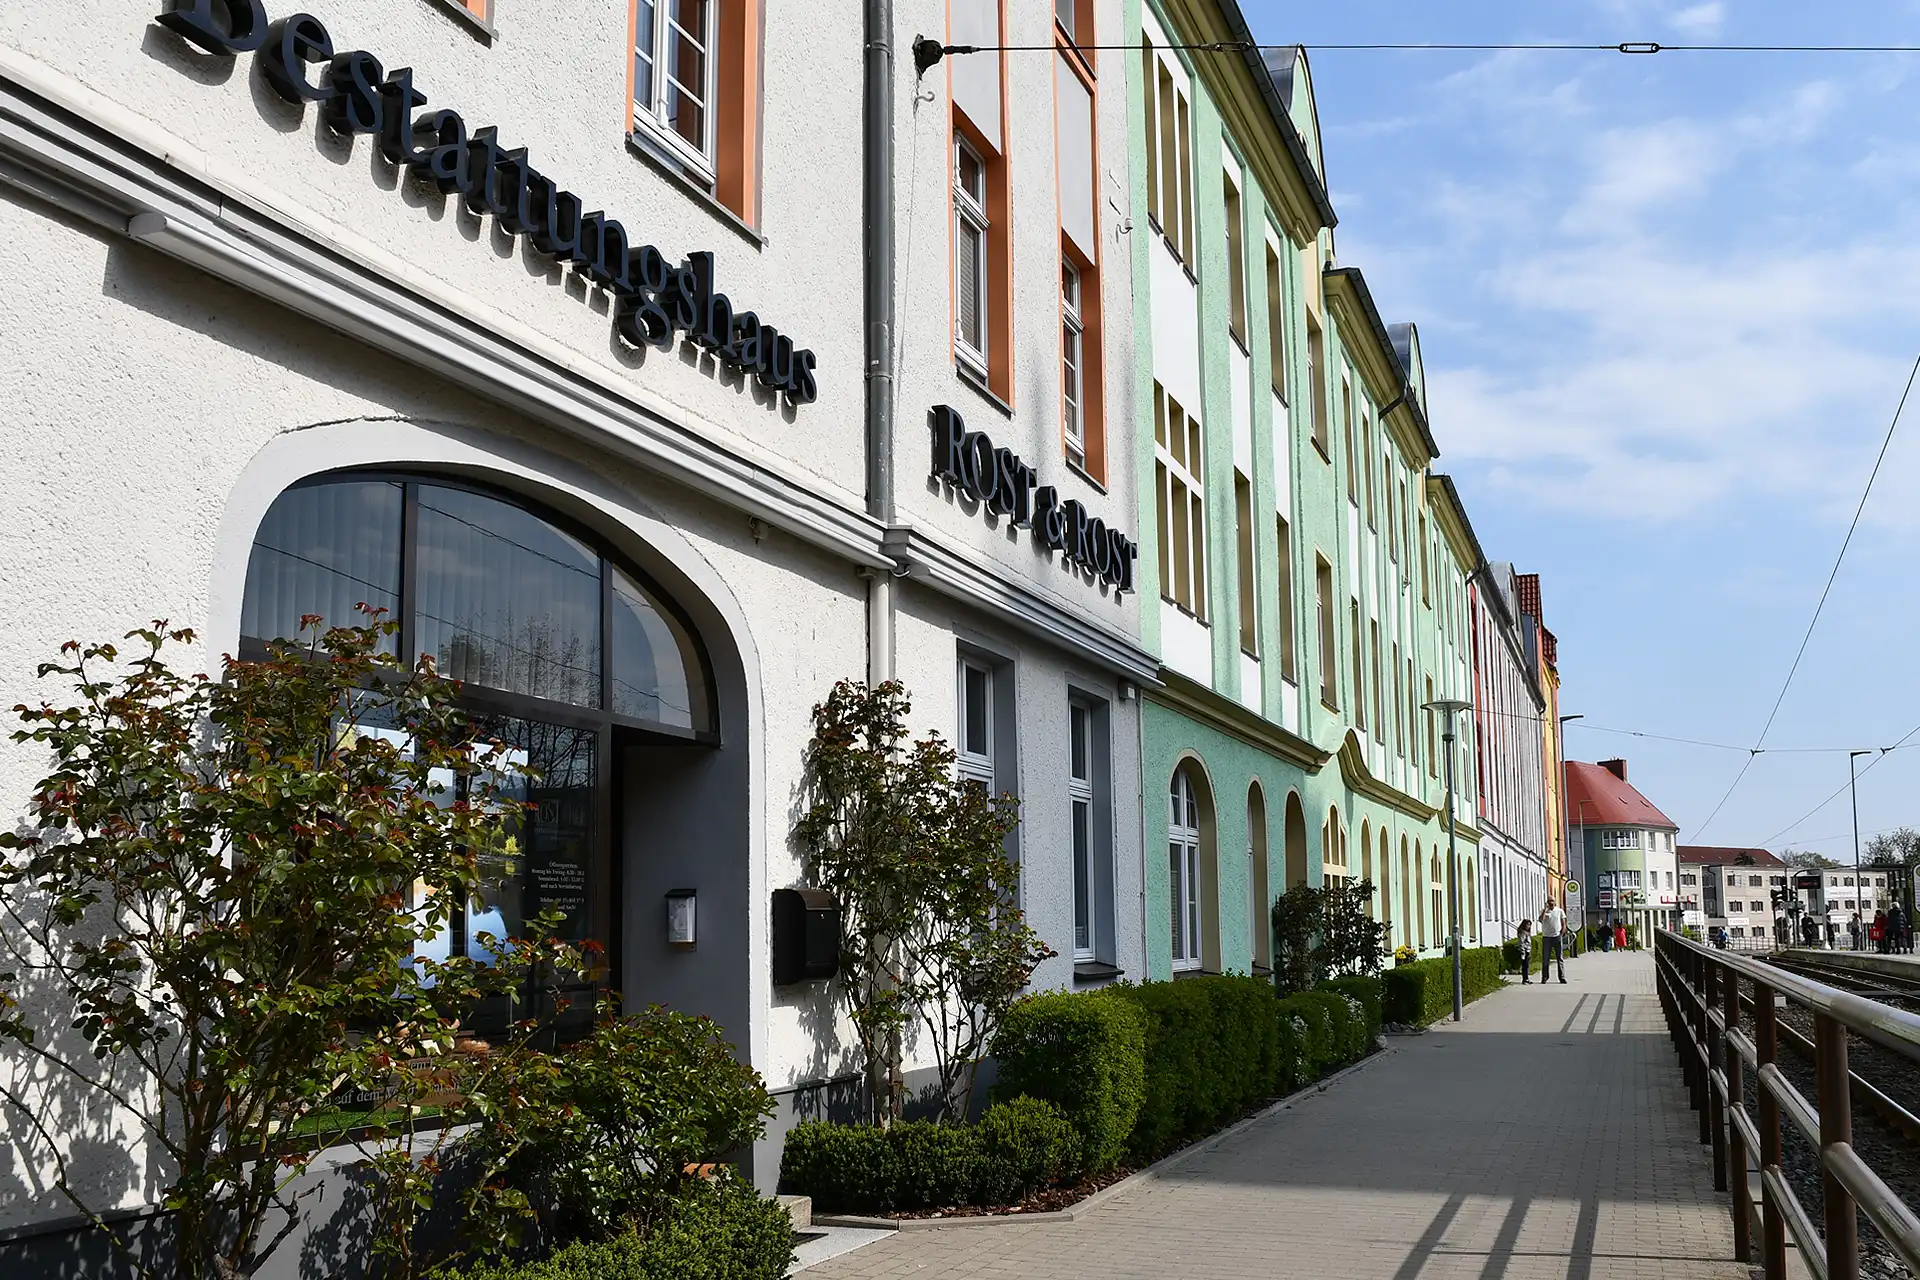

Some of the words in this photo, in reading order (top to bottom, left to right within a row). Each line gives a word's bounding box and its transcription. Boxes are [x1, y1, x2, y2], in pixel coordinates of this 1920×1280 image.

[931, 405, 1037, 529] ROST
[1032, 486, 1068, 550] &
[1063, 499, 1138, 594] ROST
[356, 1090, 380, 1102] dem
